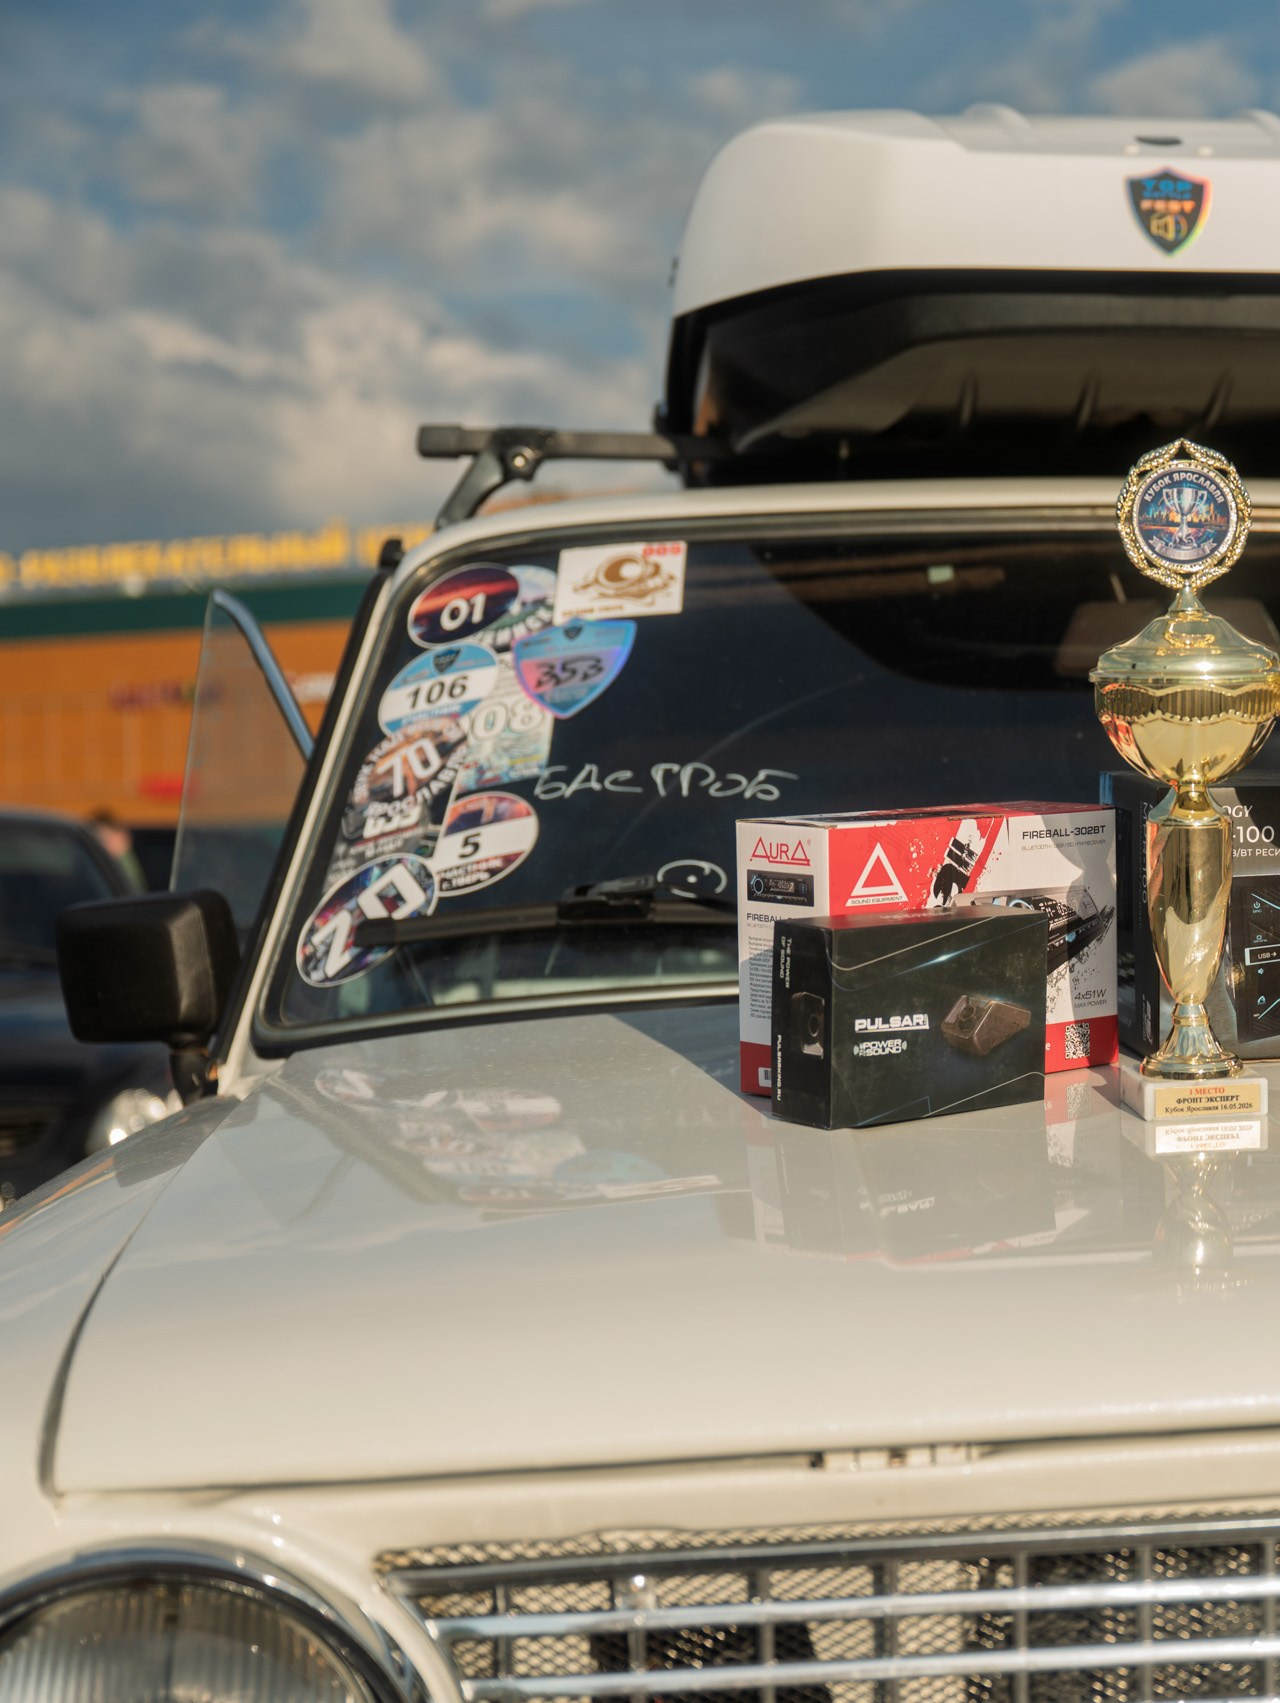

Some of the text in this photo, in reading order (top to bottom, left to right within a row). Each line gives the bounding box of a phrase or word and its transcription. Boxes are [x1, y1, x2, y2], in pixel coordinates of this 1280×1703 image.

[1144, 472, 1225, 504] КУБОК ЯРОСЛАВЛЯ
[440, 592, 487, 631] 01
[408, 675, 469, 710] 106
[376, 737, 443, 798] 70
[534, 763, 643, 799] БАС
[1022, 825, 1106, 840] FIREBALL-302BT
[1232, 825, 1275, 843] -100
[458, 832, 481, 859] 5
[751, 836, 811, 866] AURA
[872, 895, 903, 904] EQUIPMENT
[1075, 988, 1107, 1000] 4x51W
[1086, 1000, 1107, 1008] POWER
[855, 1014, 924, 1032] PULSAR
[863, 1039, 902, 1049] POWER
[865, 1046, 902, 1056] SOUND
[1195, 1087, 1225, 1095] МЕСТО
[1176, 1095, 1240, 1104] ФРОНТ ЭКСПЕРТ
[1165, 1106, 1184, 1114] Кубок
[1186, 1105, 1219, 1113] Ярославля
